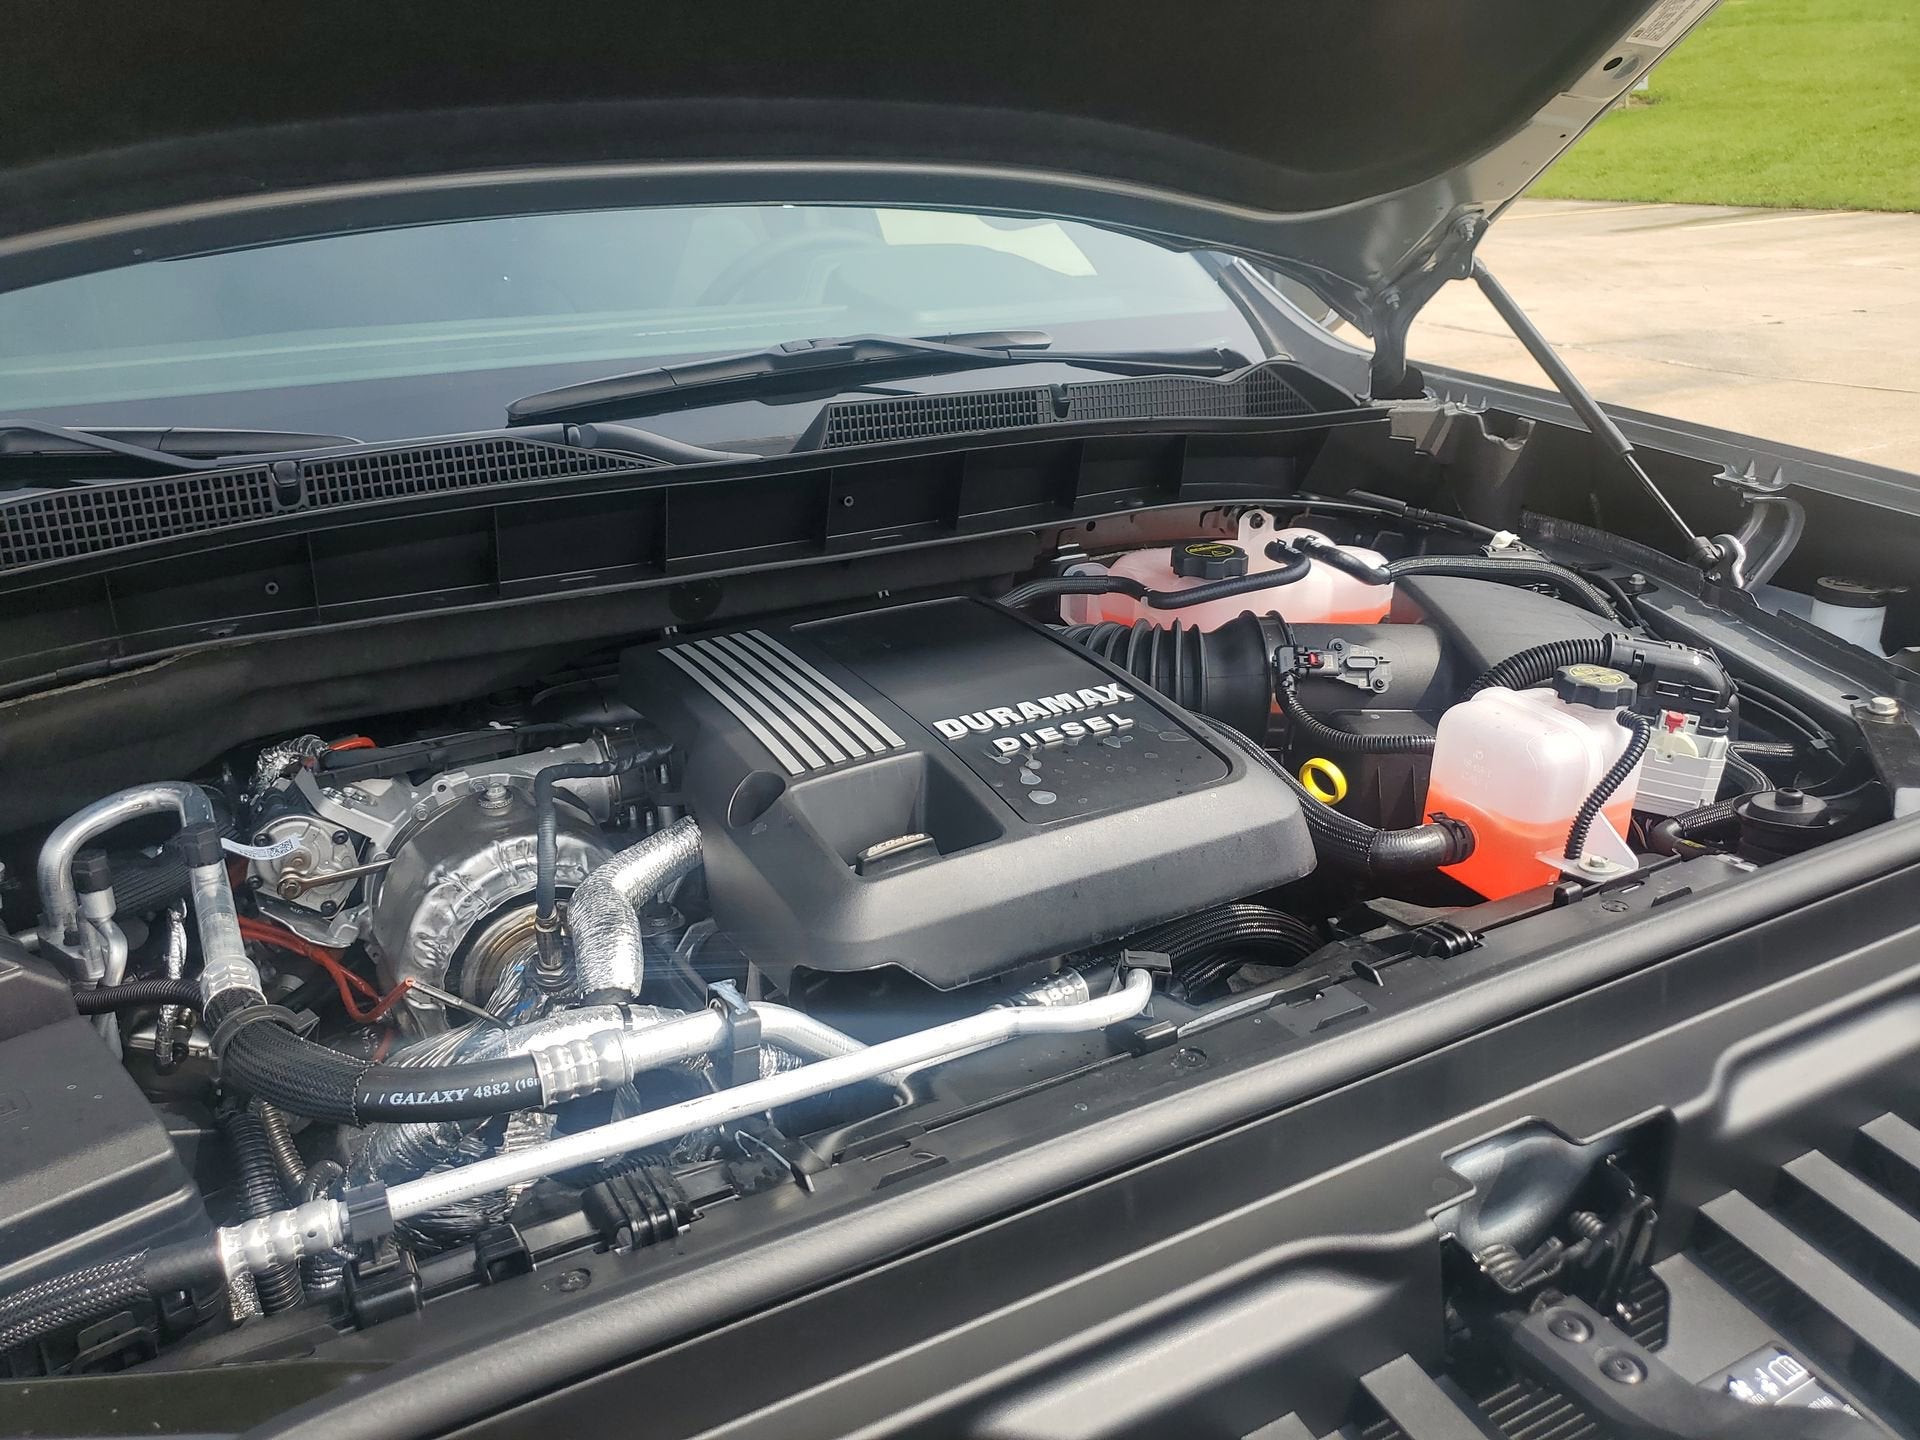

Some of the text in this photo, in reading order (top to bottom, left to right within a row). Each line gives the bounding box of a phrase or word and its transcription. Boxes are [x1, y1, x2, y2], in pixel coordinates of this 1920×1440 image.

[933, 683, 1135, 740] DURAMAX
[992, 713, 1134, 755] DIESEL
[389, 1087, 470, 1105] GALAXY
[473, 1082, 511, 1099] 4882
